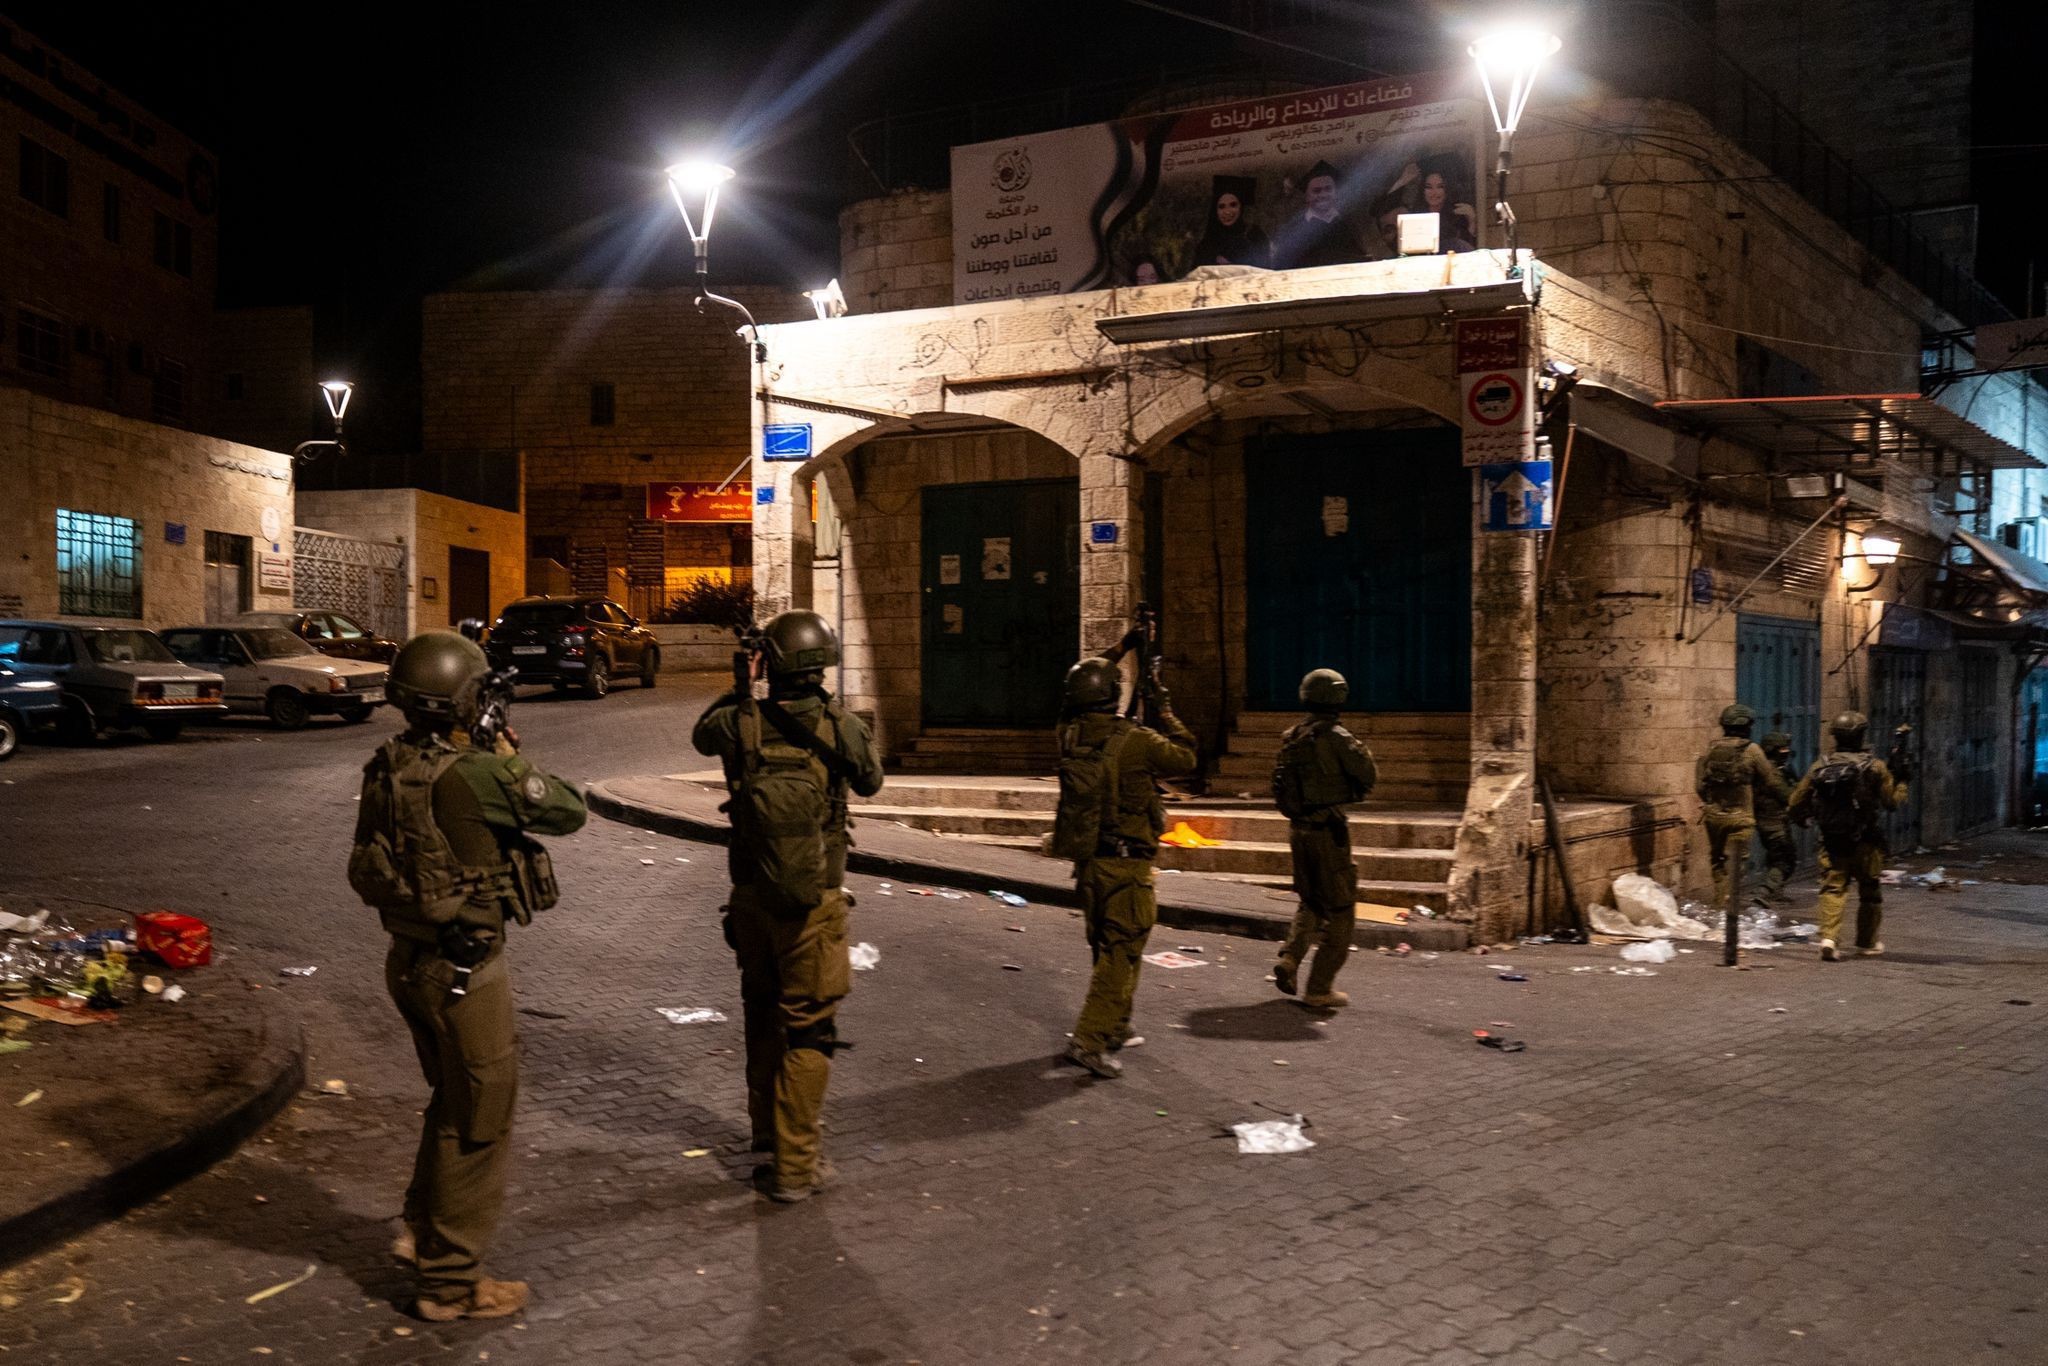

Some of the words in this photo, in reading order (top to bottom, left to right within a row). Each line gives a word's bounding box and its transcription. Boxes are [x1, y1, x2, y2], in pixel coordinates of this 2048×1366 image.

[1344, 84, 1413, 108] فضاءات
[1210, 104, 1277, 130] والريادة
[1281, 94, 1339, 123] للإبداع
[1325, 120, 1356, 136] برامج
[1211, 135, 1241, 152] برامج
[1023, 204, 1039, 217] دار
[971, 233, 1000, 249] صون
[1003, 222, 1028, 244] أجل
[1032, 224, 1052, 240] من
[966, 258, 1010, 275] ووطننا
[1013, 248, 1058, 268] ثقافتنا
[1017, 278, 1061, 298] وتنمية
